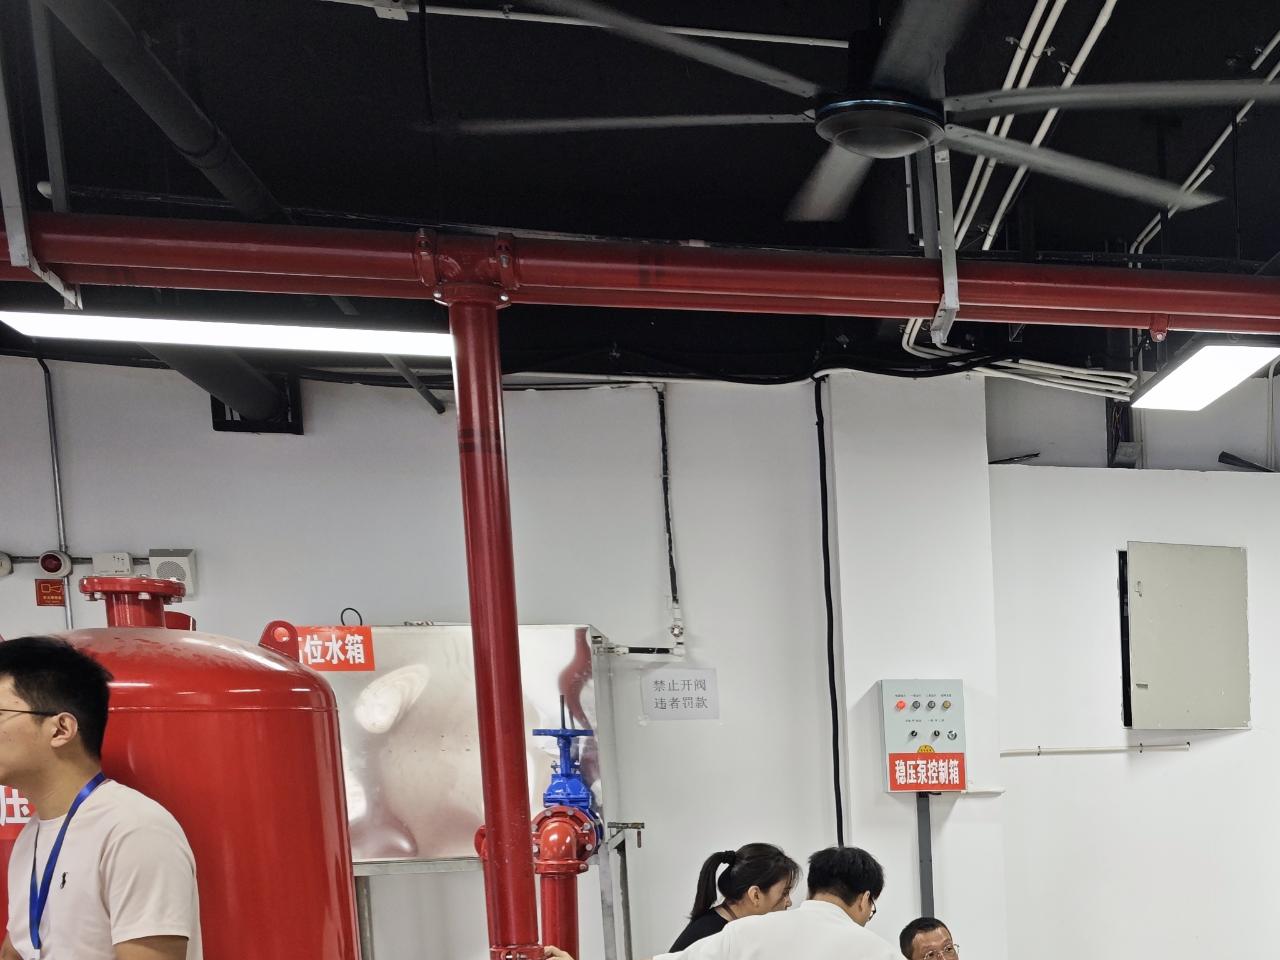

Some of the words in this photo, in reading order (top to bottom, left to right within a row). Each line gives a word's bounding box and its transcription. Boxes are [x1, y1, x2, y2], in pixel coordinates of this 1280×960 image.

[653, 679, 707, 692] 禁止开阀
[653, 696, 709, 710] 违者罚款
[895, 759, 960, 784] 稳压泵控制箱
